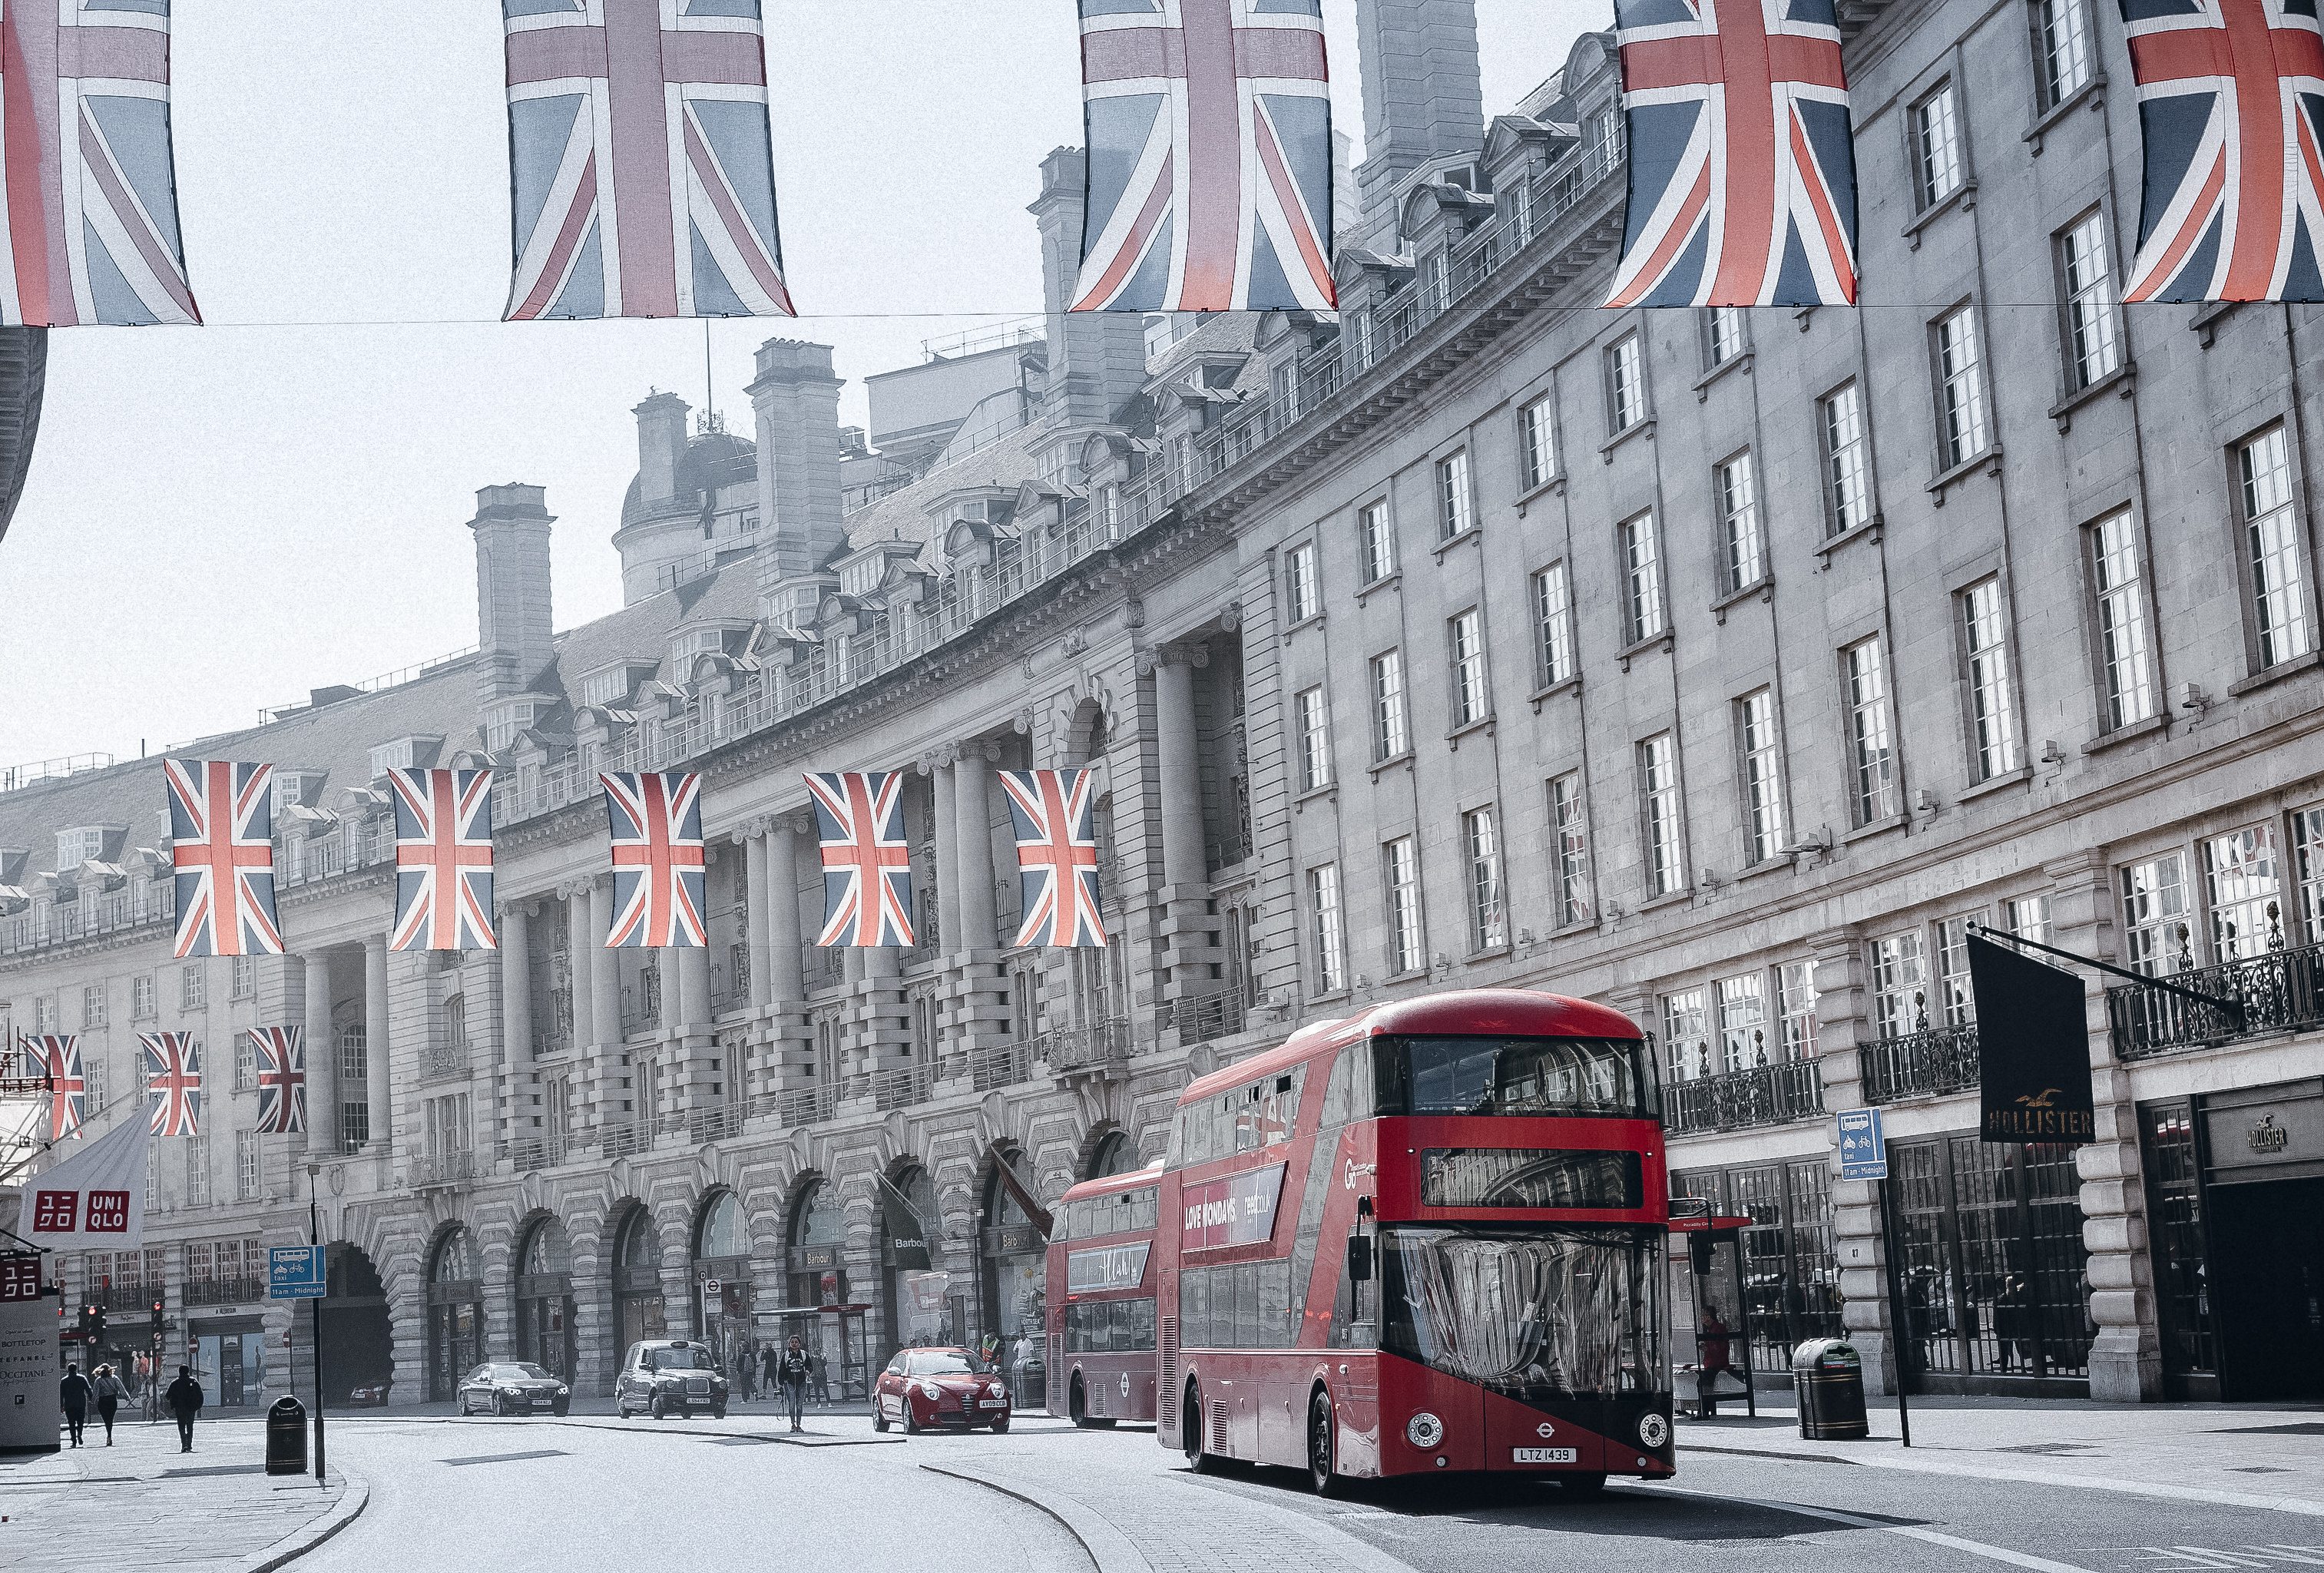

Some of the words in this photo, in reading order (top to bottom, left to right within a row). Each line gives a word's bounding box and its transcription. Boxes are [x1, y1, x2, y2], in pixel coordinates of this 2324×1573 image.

[1989, 1110, 2091, 1134] HOLLISTER
[2246, 1128, 2285, 1147] HOLLISTER
[1844, 1167, 1858, 1176] 11am
[1860, 1165, 1885, 1175] Midnight
[92, 1196, 121, 1210] UNI
[91, 1213, 123, 1229] QLO
[1185, 1204, 1202, 1230] LOVE
[1003, 1234, 1028, 1247] Barbour
[807, 1252, 829, 1264] Barbour
[1, 1339, 46, 1348] BOTTLETOP
